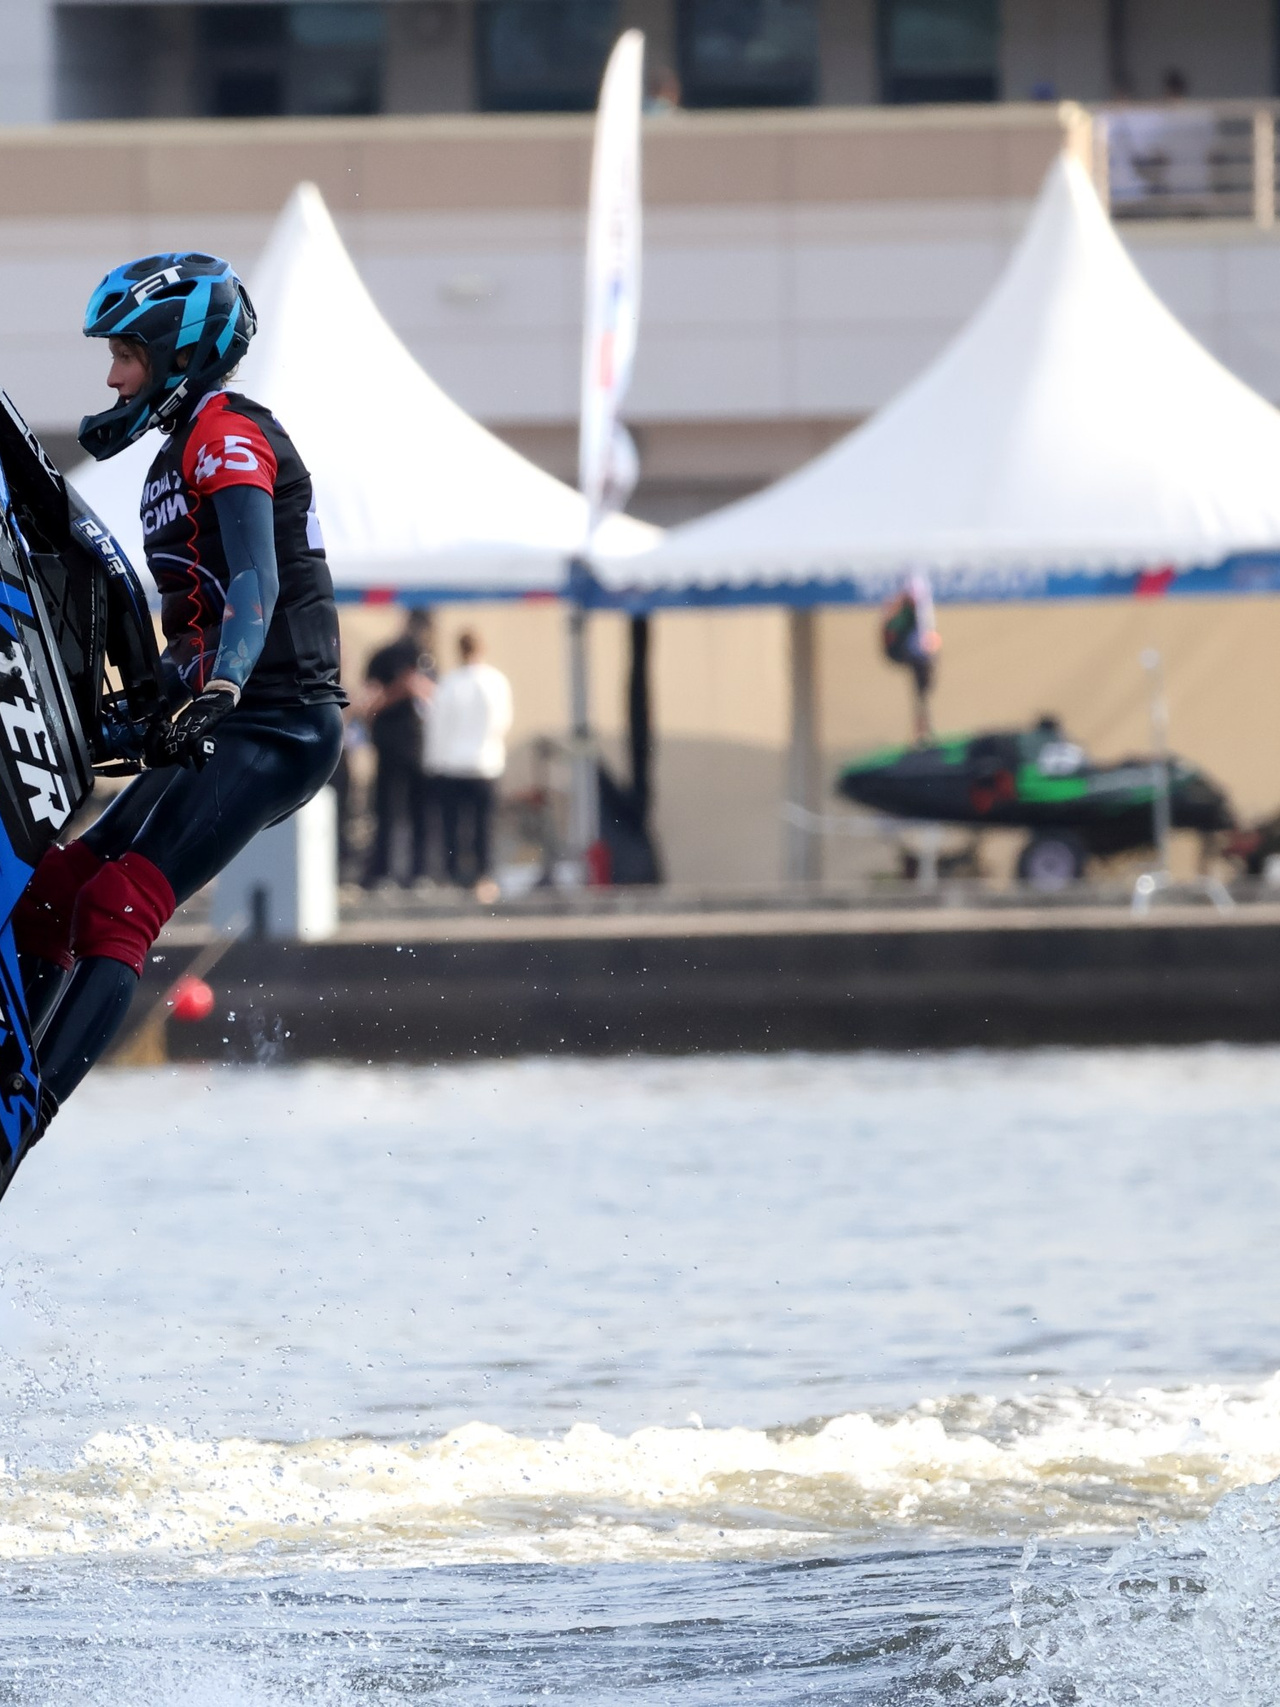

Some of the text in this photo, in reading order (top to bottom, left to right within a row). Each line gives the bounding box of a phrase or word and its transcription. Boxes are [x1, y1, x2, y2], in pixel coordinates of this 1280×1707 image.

[131, 377, 189, 441] MET
[194, 435, 259, 485] 45
[79, 519, 127, 575] RRP
